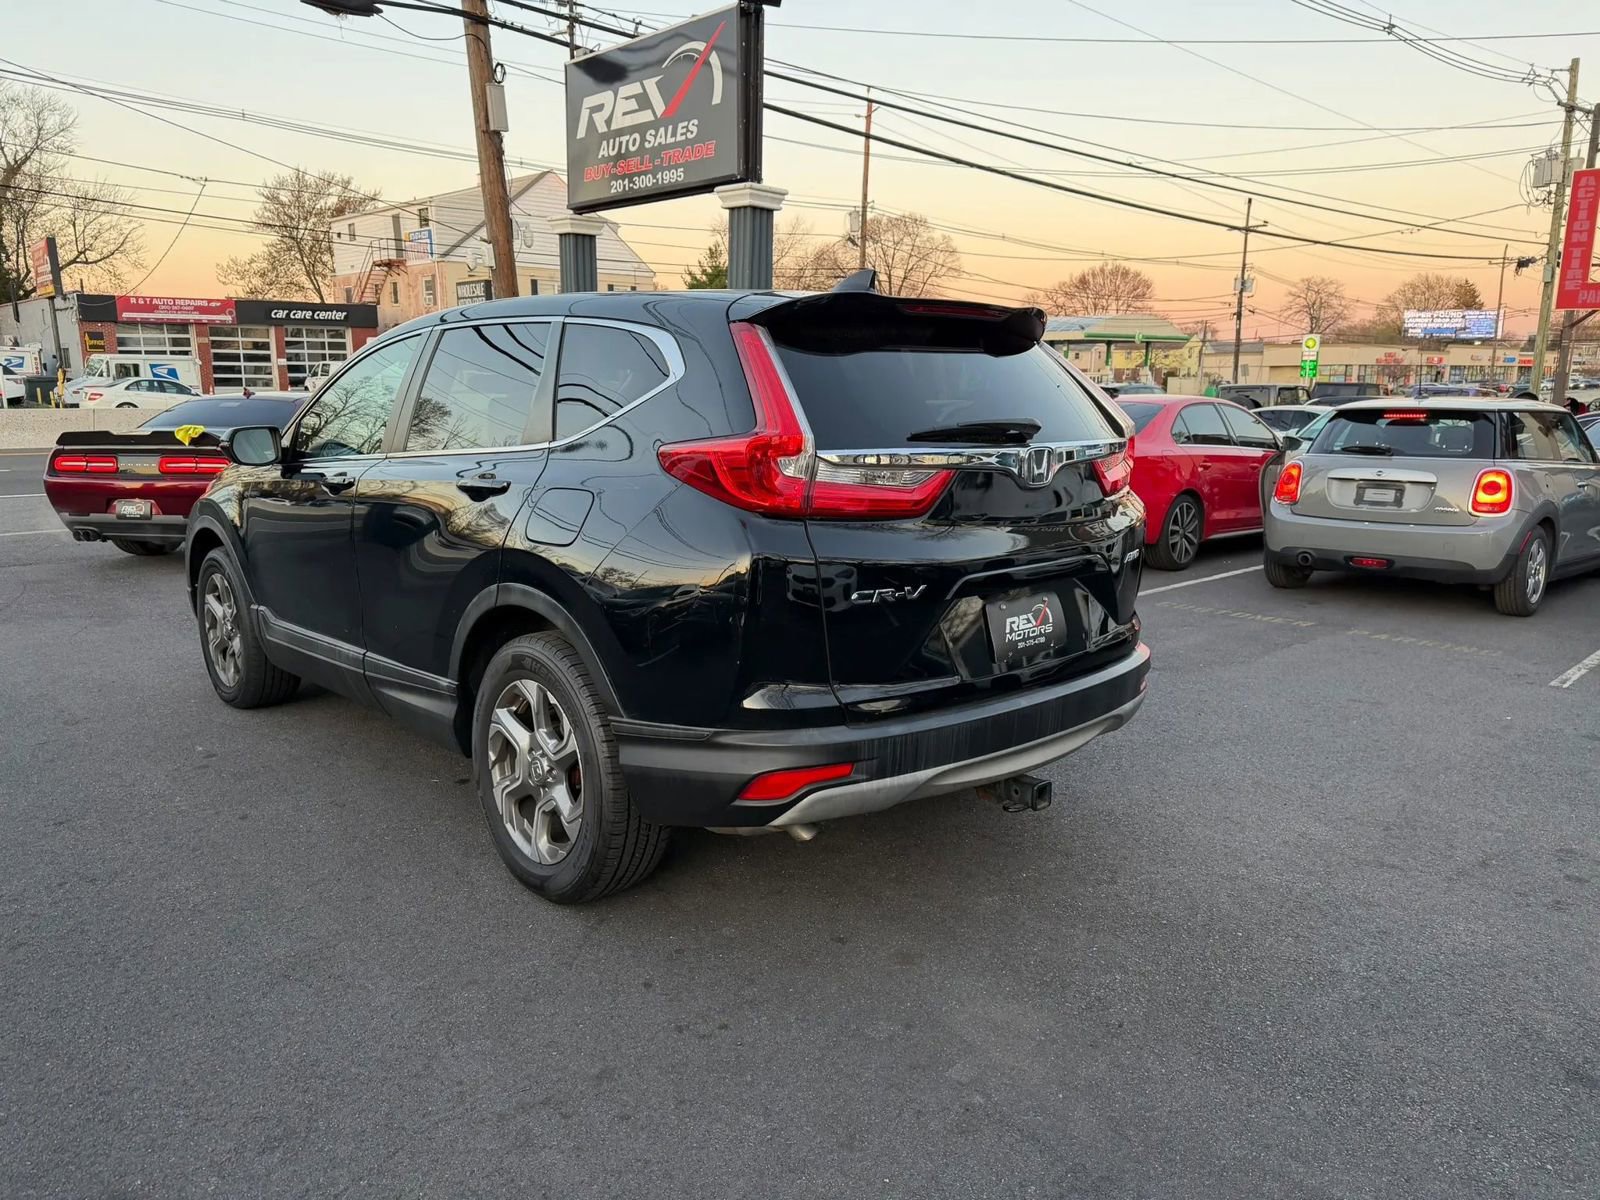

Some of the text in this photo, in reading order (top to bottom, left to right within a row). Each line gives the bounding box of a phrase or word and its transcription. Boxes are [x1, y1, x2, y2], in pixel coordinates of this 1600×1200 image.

[576, 20, 727, 139] REV
[598, 119, 698, 159] AUTO SALES
[610, 168, 685, 194] 201-300-1995
[1564, 175, 1596, 290] ACTION TIRE
[152, 298, 174, 306] AUTO
[175, 299, 208, 307] REPAIRS
[271, 309, 348, 320] car care center
[851, 584, 927, 605] CR-V
[1005, 600, 1053, 633] REV
[1005, 624, 1053, 643] MOTORS
